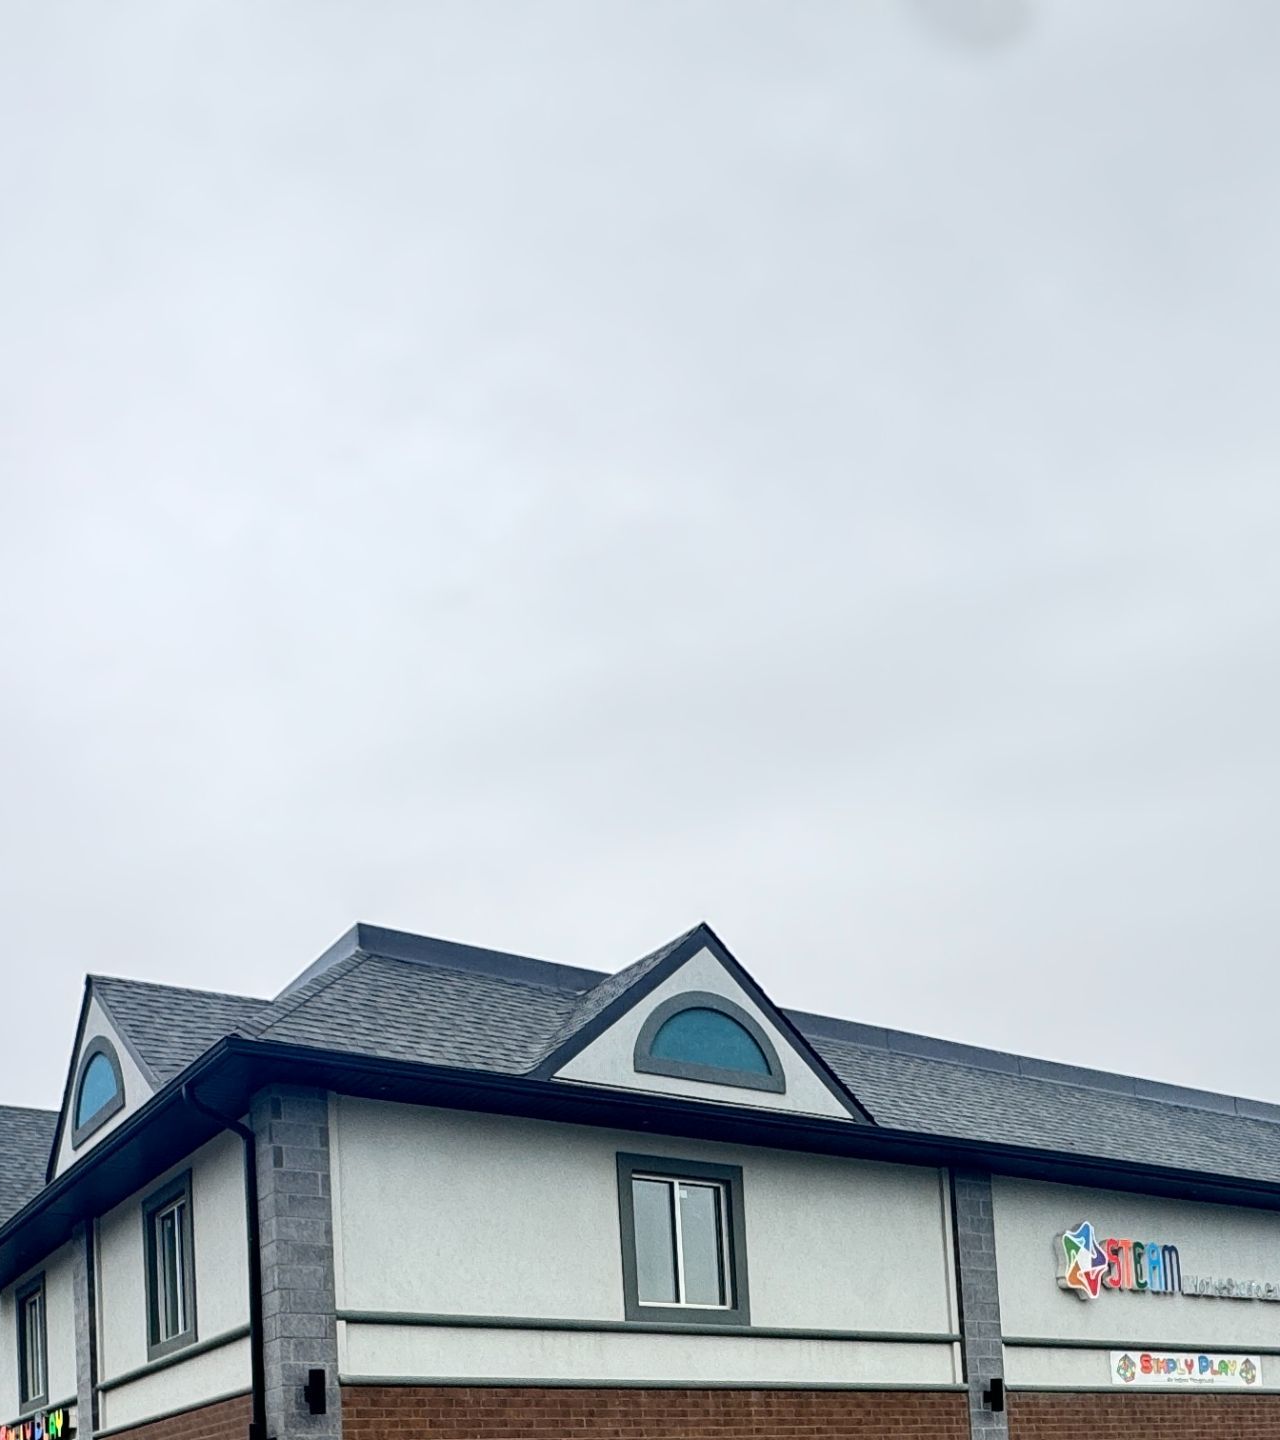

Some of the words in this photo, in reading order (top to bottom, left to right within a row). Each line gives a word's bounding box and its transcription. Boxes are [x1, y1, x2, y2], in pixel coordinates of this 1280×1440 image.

[1105, 1238, 1182, 1292] STEAM
[1139, 1353, 1194, 1375] SIMPLY
[1198, 1355, 1238, 1377] PLAY
